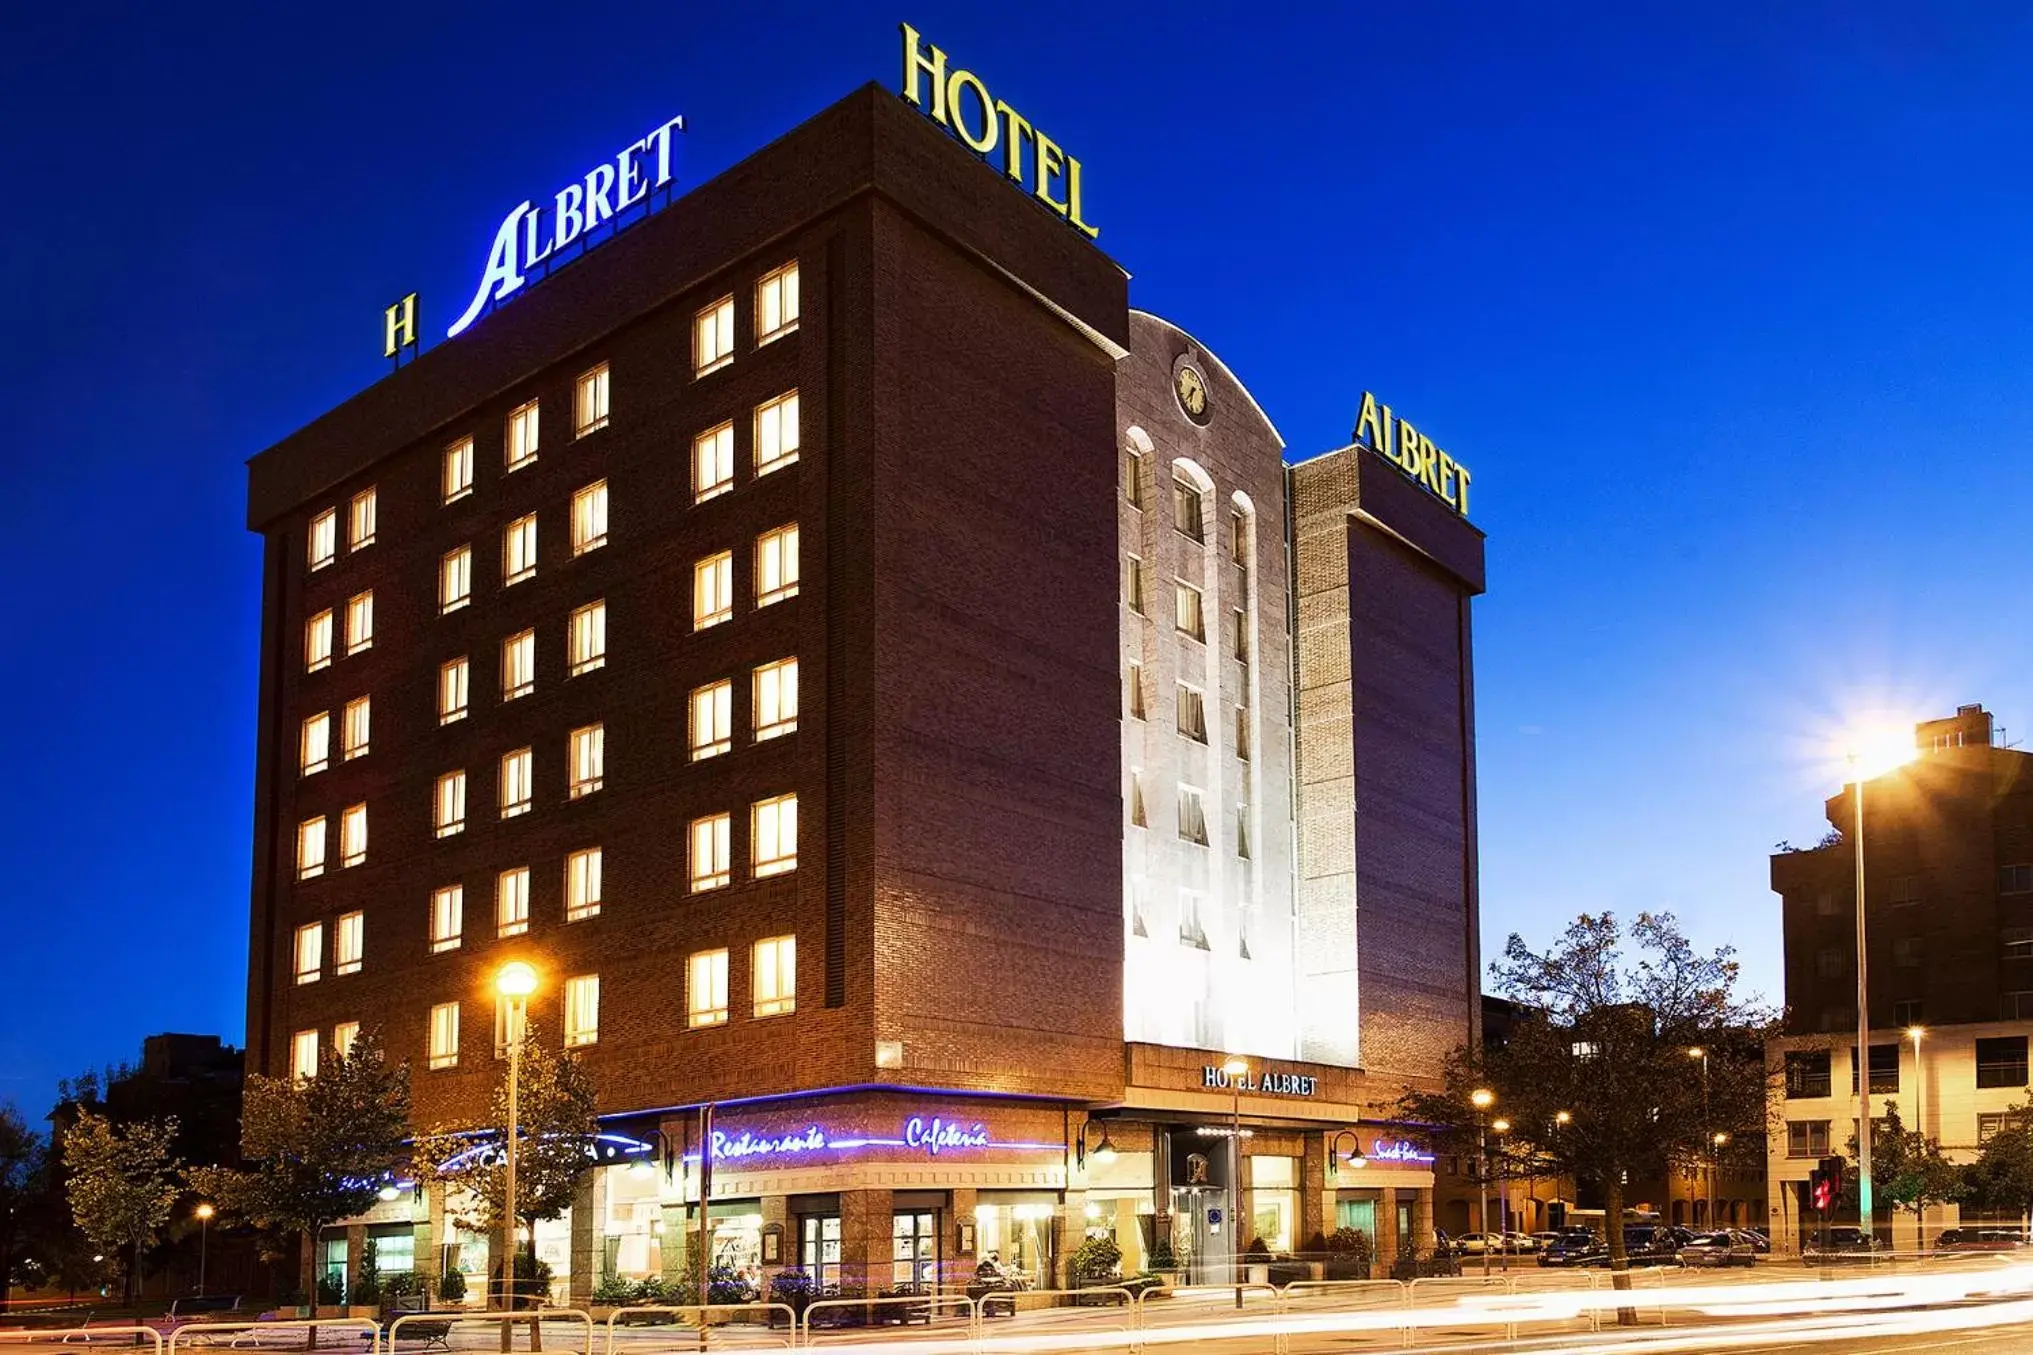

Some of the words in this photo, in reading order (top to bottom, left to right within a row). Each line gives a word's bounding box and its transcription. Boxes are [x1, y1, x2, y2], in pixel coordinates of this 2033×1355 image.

[902, 22, 1099, 238] HOTEL
[447, 114, 683, 337] ALBRET
[384, 292, 416, 356] H
[1357, 391, 1471, 516] ALBRET
[1205, 1066, 1257, 1090] HOTEL
[1262, 1073, 1318, 1095] ALBRET
[711, 1126, 825, 1158] Restaurante
